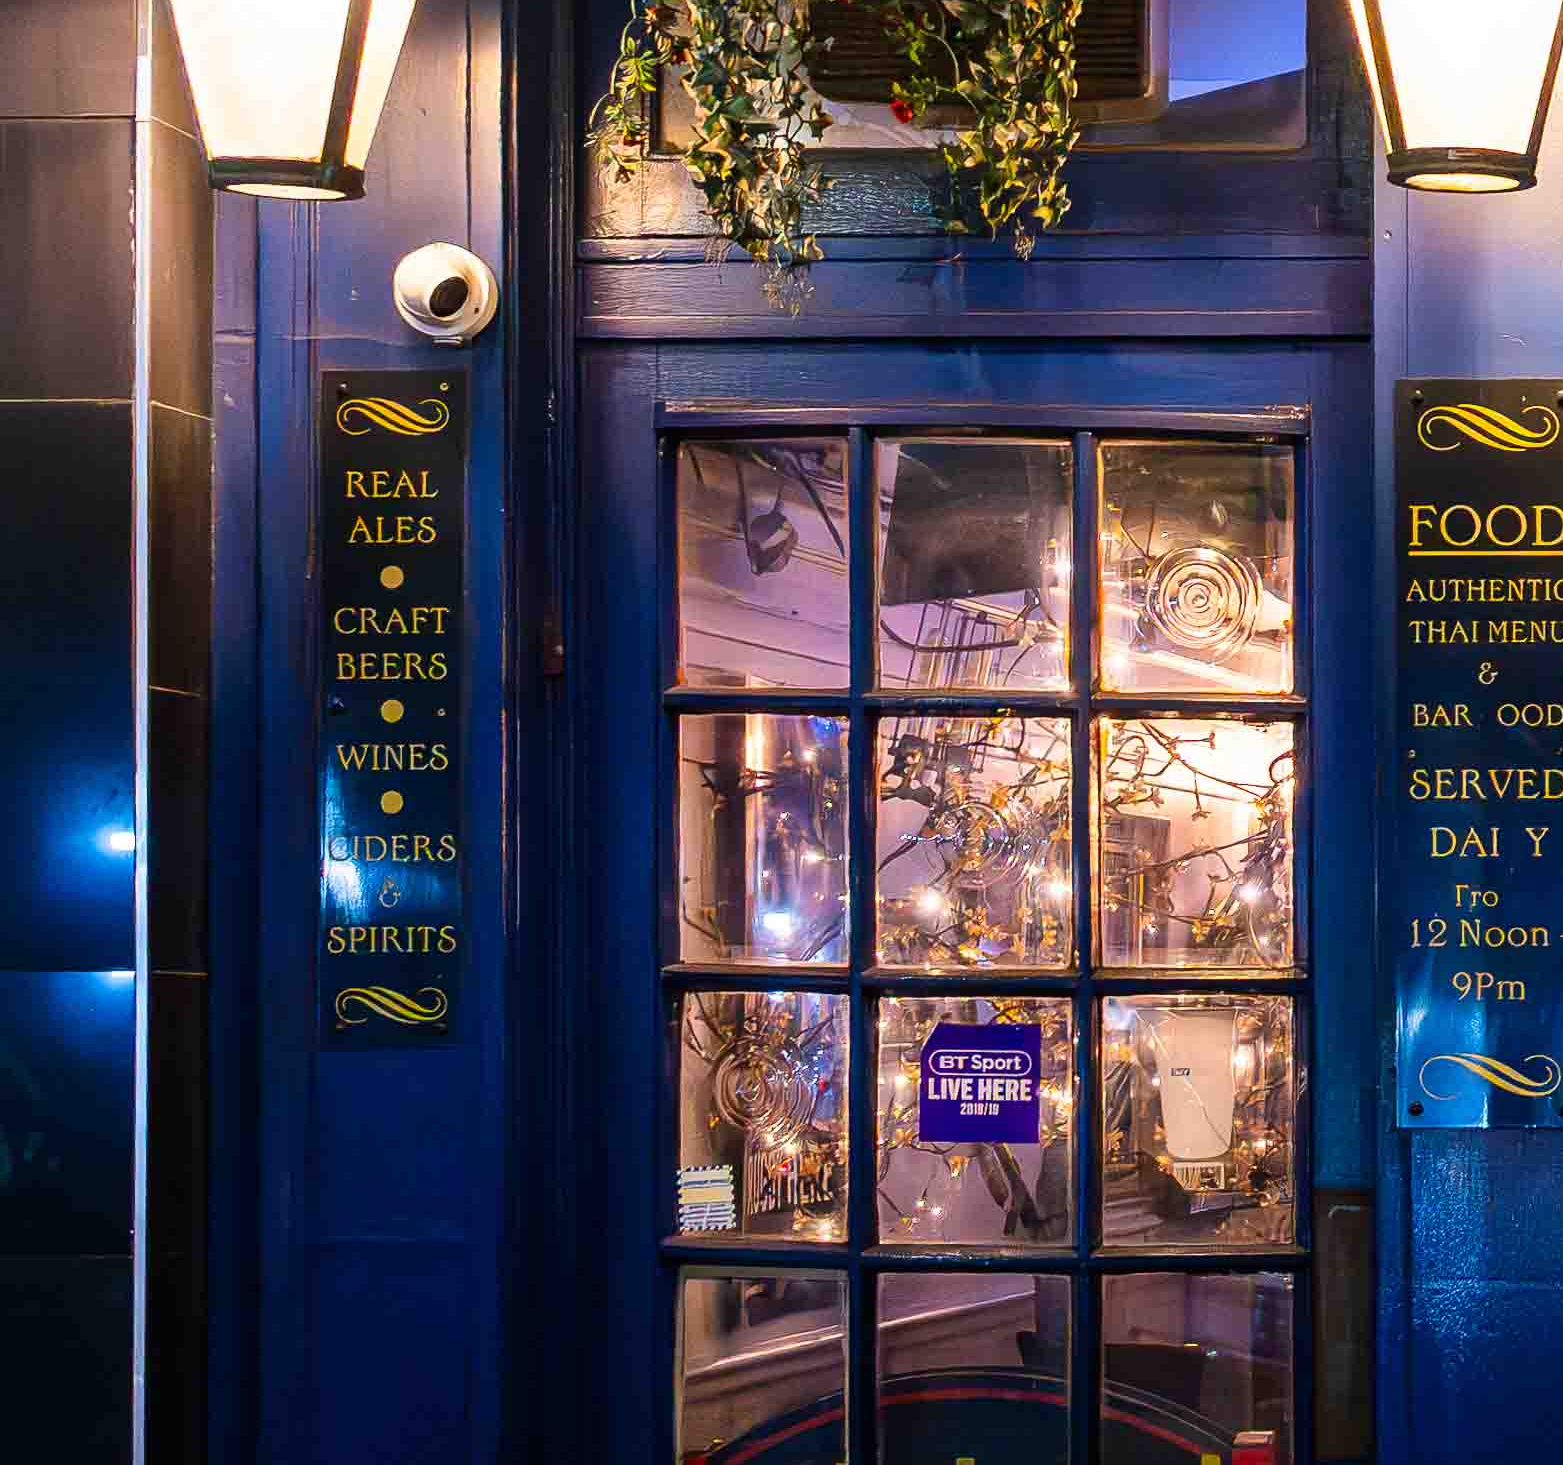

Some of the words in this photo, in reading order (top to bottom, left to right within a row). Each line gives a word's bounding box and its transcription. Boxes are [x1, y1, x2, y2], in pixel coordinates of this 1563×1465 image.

[344, 470, 439, 498] REAL
[348, 516, 437, 544] ALES
[334, 607, 450, 635] CRAFT
[1408, 620, 1479, 645] THAI
[336, 652, 448, 680] BEERS
[1478, 662, 1498, 685] &
[1413, 704, 1473, 727] BAR
[336, 743, 449, 772] WINES
[329, 835, 457, 862] CIDERS
[1430, 827, 1550, 858] DAIY
[378, 877, 401, 908] &
[328, 926, 457, 954] SPIRITS
[1411, 917, 1448, 948] 12
[1459, 919, 1550, 948] Noon
[1452, 971, 1526, 1001] 9Pm
[939, 1055, 969, 1069] BT
[970, 1054, 1022, 1072] Sport
[927, 1077, 974, 1101] LIVE
[977, 1077, 1033, 1101] HERE
